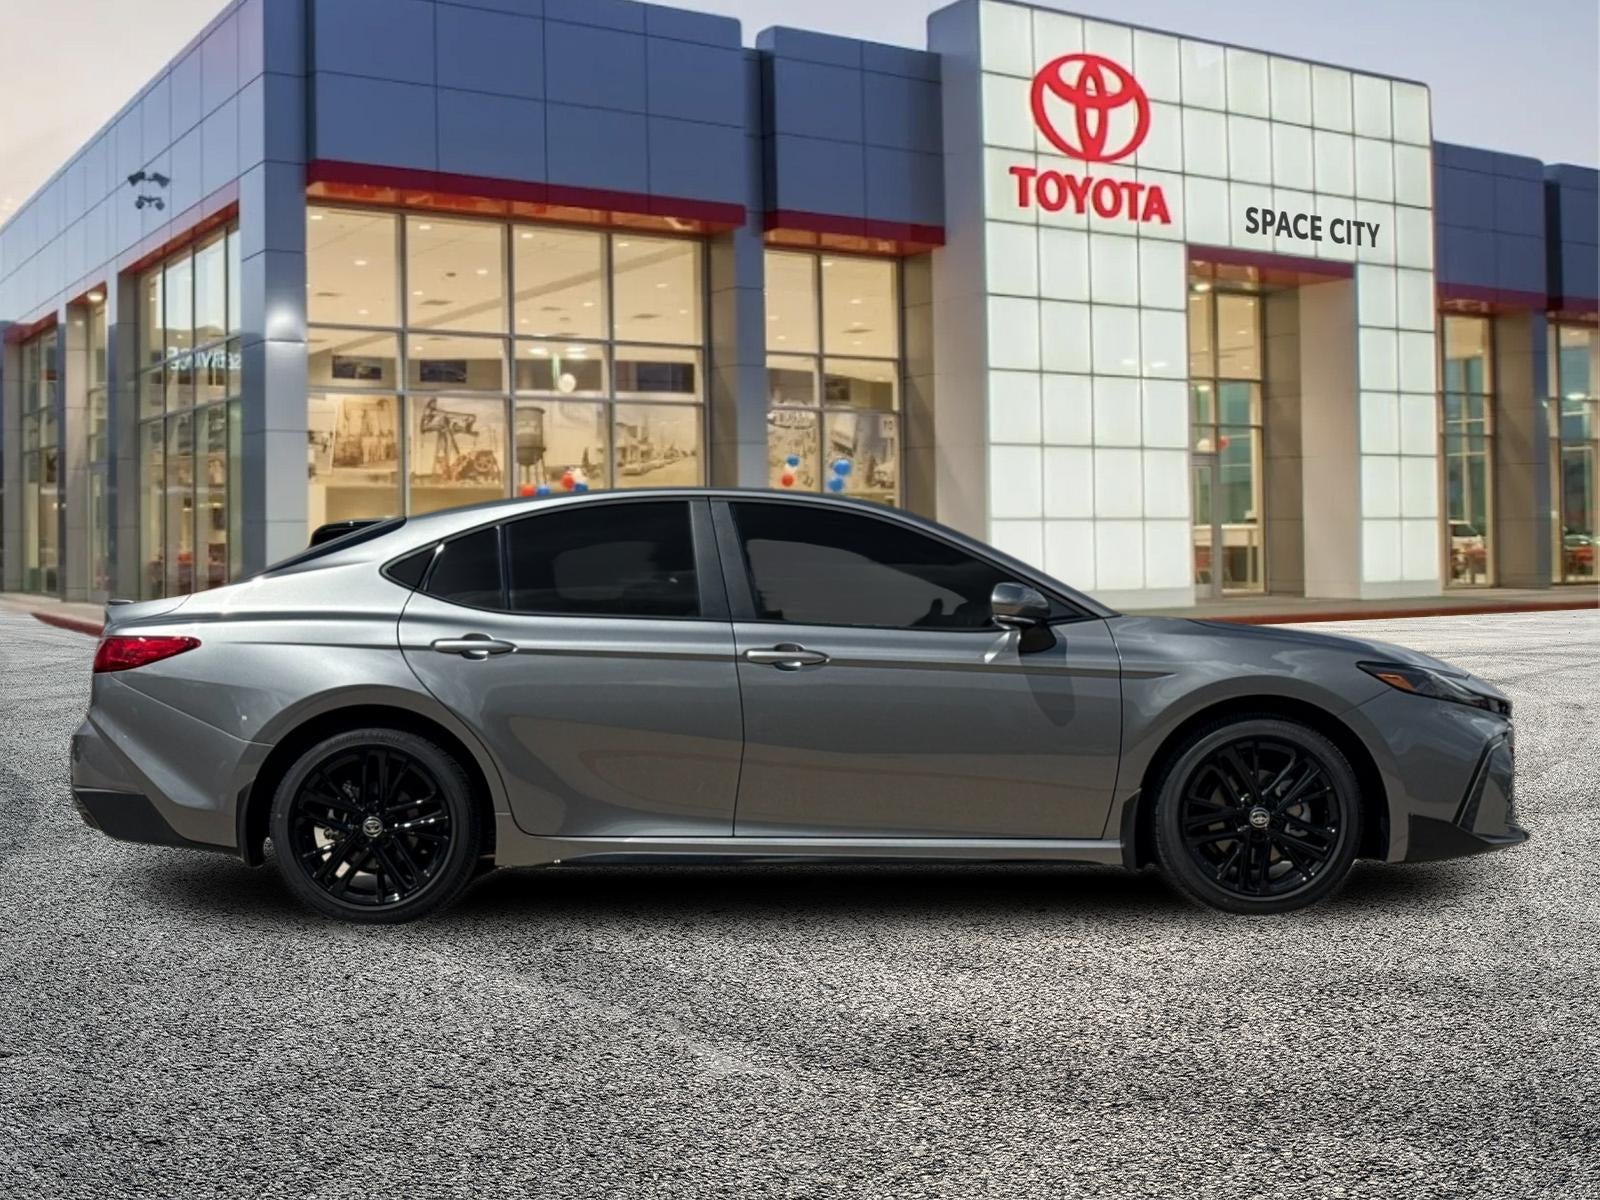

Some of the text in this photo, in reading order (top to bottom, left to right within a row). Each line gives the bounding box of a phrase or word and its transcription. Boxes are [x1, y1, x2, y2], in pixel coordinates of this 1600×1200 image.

[1009, 166, 1171, 225] TOYOTA
[1245, 206, 1381, 248] SPACE CITY
